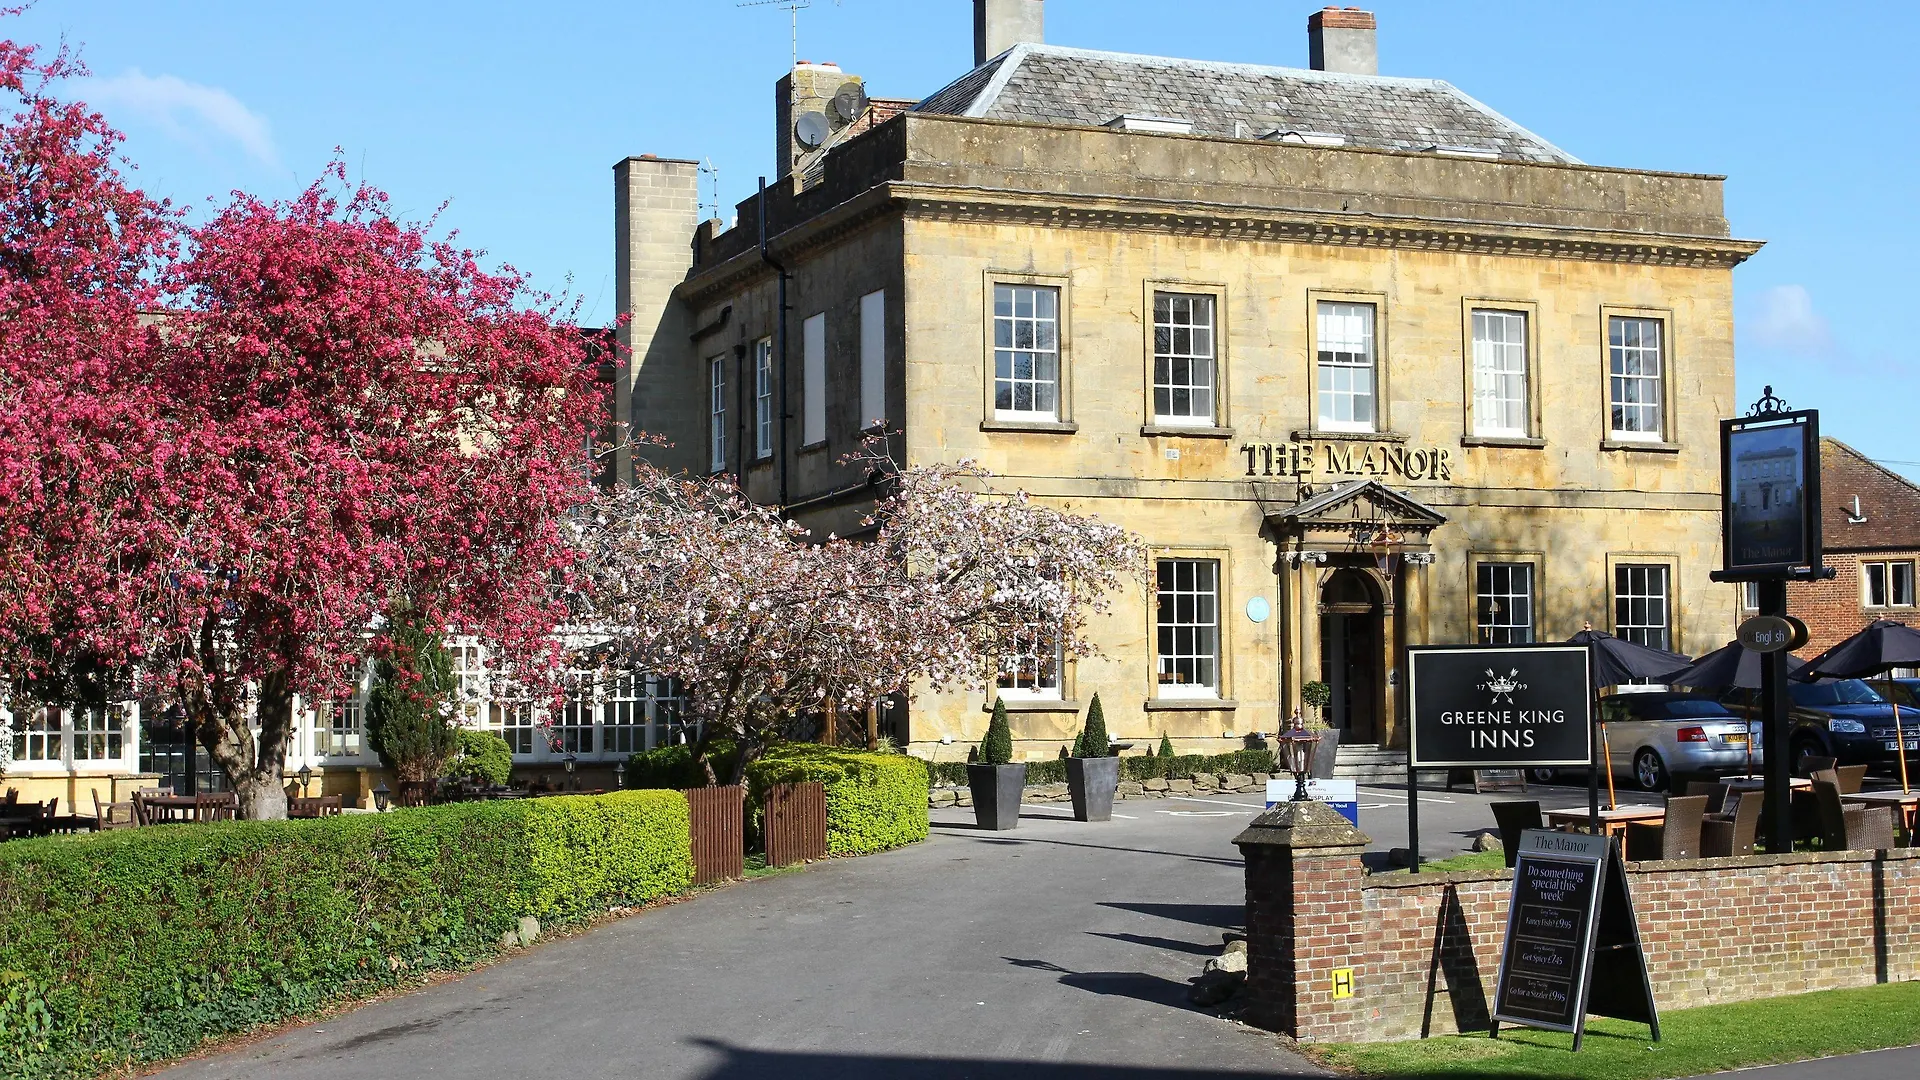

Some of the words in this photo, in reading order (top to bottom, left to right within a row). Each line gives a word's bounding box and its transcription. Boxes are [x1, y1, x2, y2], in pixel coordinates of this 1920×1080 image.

[1242, 441, 1315, 476] THE
[1325, 444, 1452, 480] MANOR
[1741, 547, 1760, 559] The
[1761, 546, 1794, 558] Manor
[1755, 630, 1785, 646] Englsh
[1518, 683, 1528, 691] 99
[1441, 710, 1512, 725] GREENE
[1519, 710, 1564, 724] KING
[1471, 730, 1535, 748] INNS
[1535, 836, 1553, 850] The
[1555, 838, 1589, 852] Manor
[1528, 865, 1539, 876] Do
[1540, 868, 1584, 883] something
[1532, 879, 1558, 890] special
[1560, 880, 1576, 891] this
[1540, 890, 1564, 902] week!
[1522, 953, 1533, 961] Get
[1533, 955, 1547, 965] Spicy
[1335, 971, 1350, 995] H
